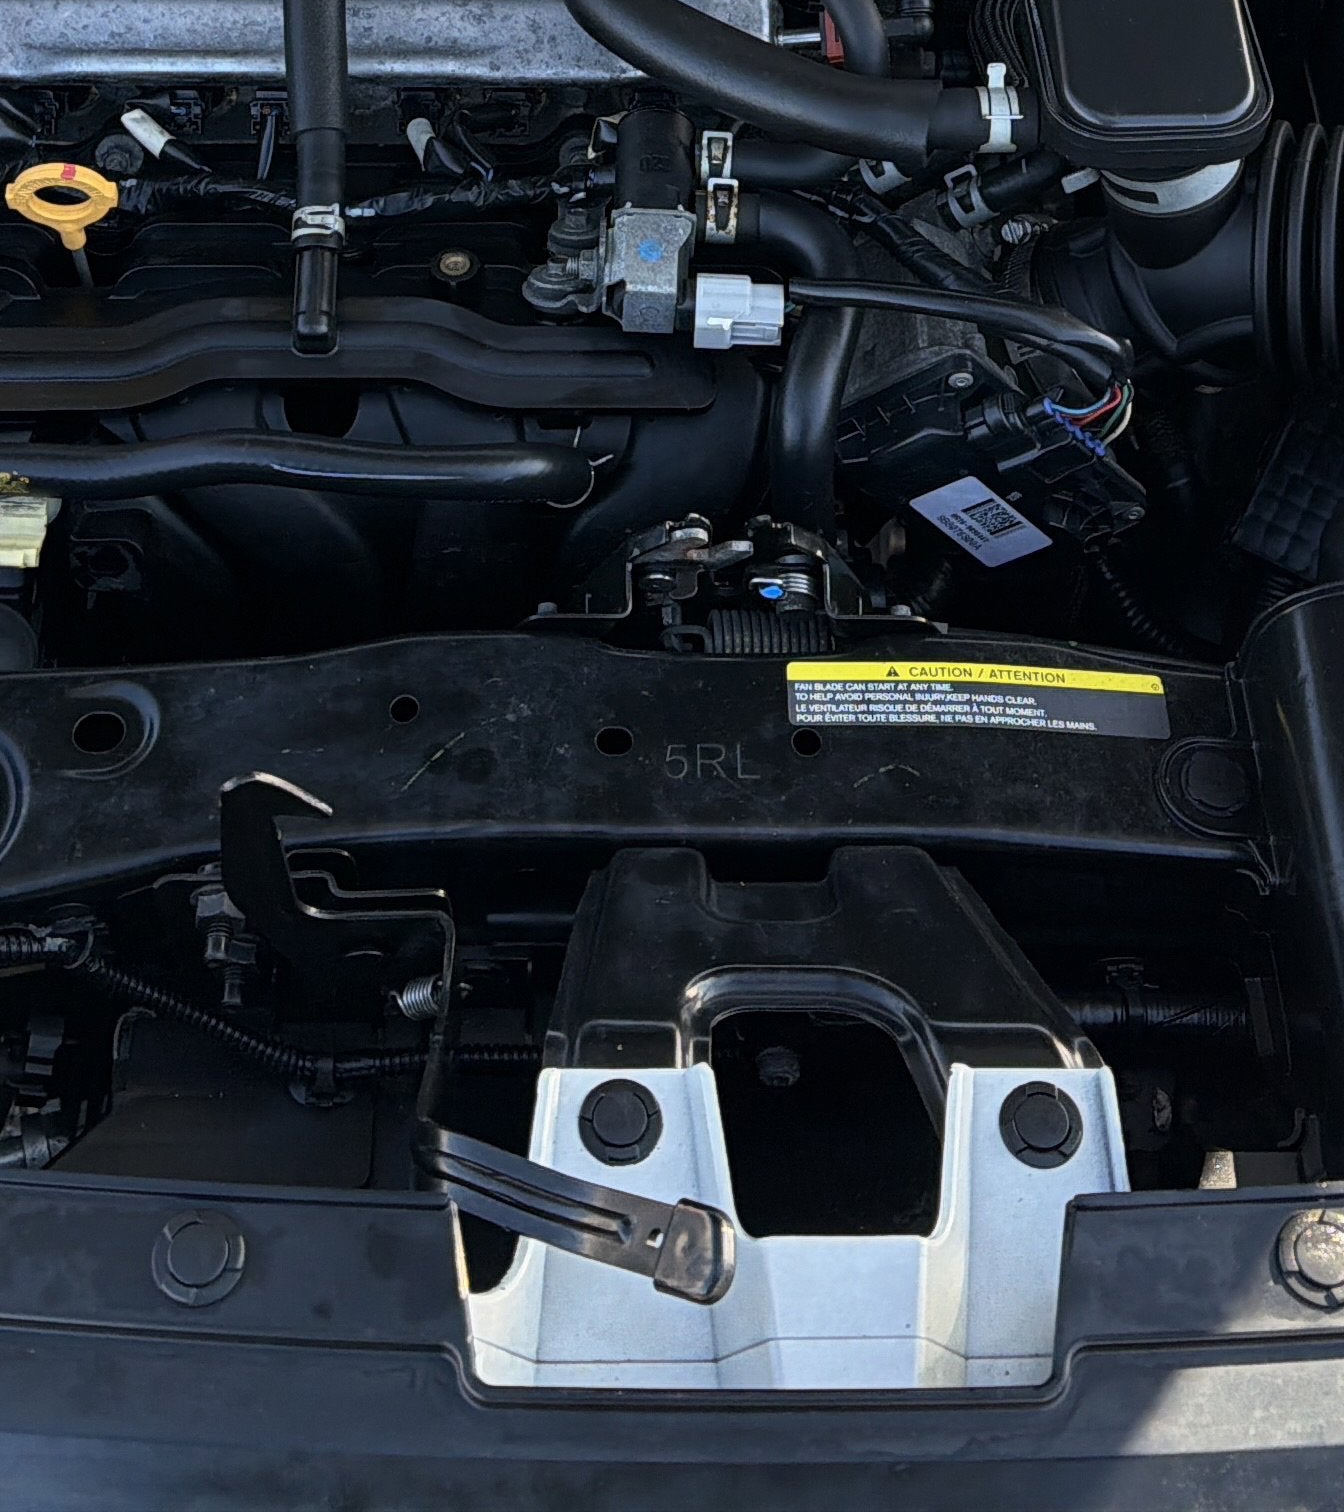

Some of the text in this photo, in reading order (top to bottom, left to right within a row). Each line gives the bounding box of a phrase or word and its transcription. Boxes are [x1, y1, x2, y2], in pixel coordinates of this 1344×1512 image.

[909, 666, 1066, 683] CAUTION / ATTENTION
[930, 683, 954, 691] TIME.
[835, 693, 863, 701] AVOID
[864, 693, 913, 701] PERSONAL
[971, 694, 1004, 703] HANDS
[1005, 695, 1037, 705] CLEAR.
[795, 704, 807, 712] LE
[808, 704, 868, 712] VENTILATEUR
[869, 704, 904, 712] RISQUE
[905, 704, 918, 712] DE
[919, 702, 970, 712] DÉMARRER
[972, 703, 980, 713] À
[981, 705, 1004, 714] TOUT
[796, 714, 823, 722] POUR
[825, 712, 855, 722] ÉVITER
[857, 714, 887, 722] TOUTE
[889, 714, 939, 723] BLESSURE,
[956, 715, 974, 723] PAS
[975, 716, 989, 724] EN
[990, 716, 1047, 727] APPROCHER
[1047, 720, 1065, 728] LES
[662, 744, 762, 779] 5RL
